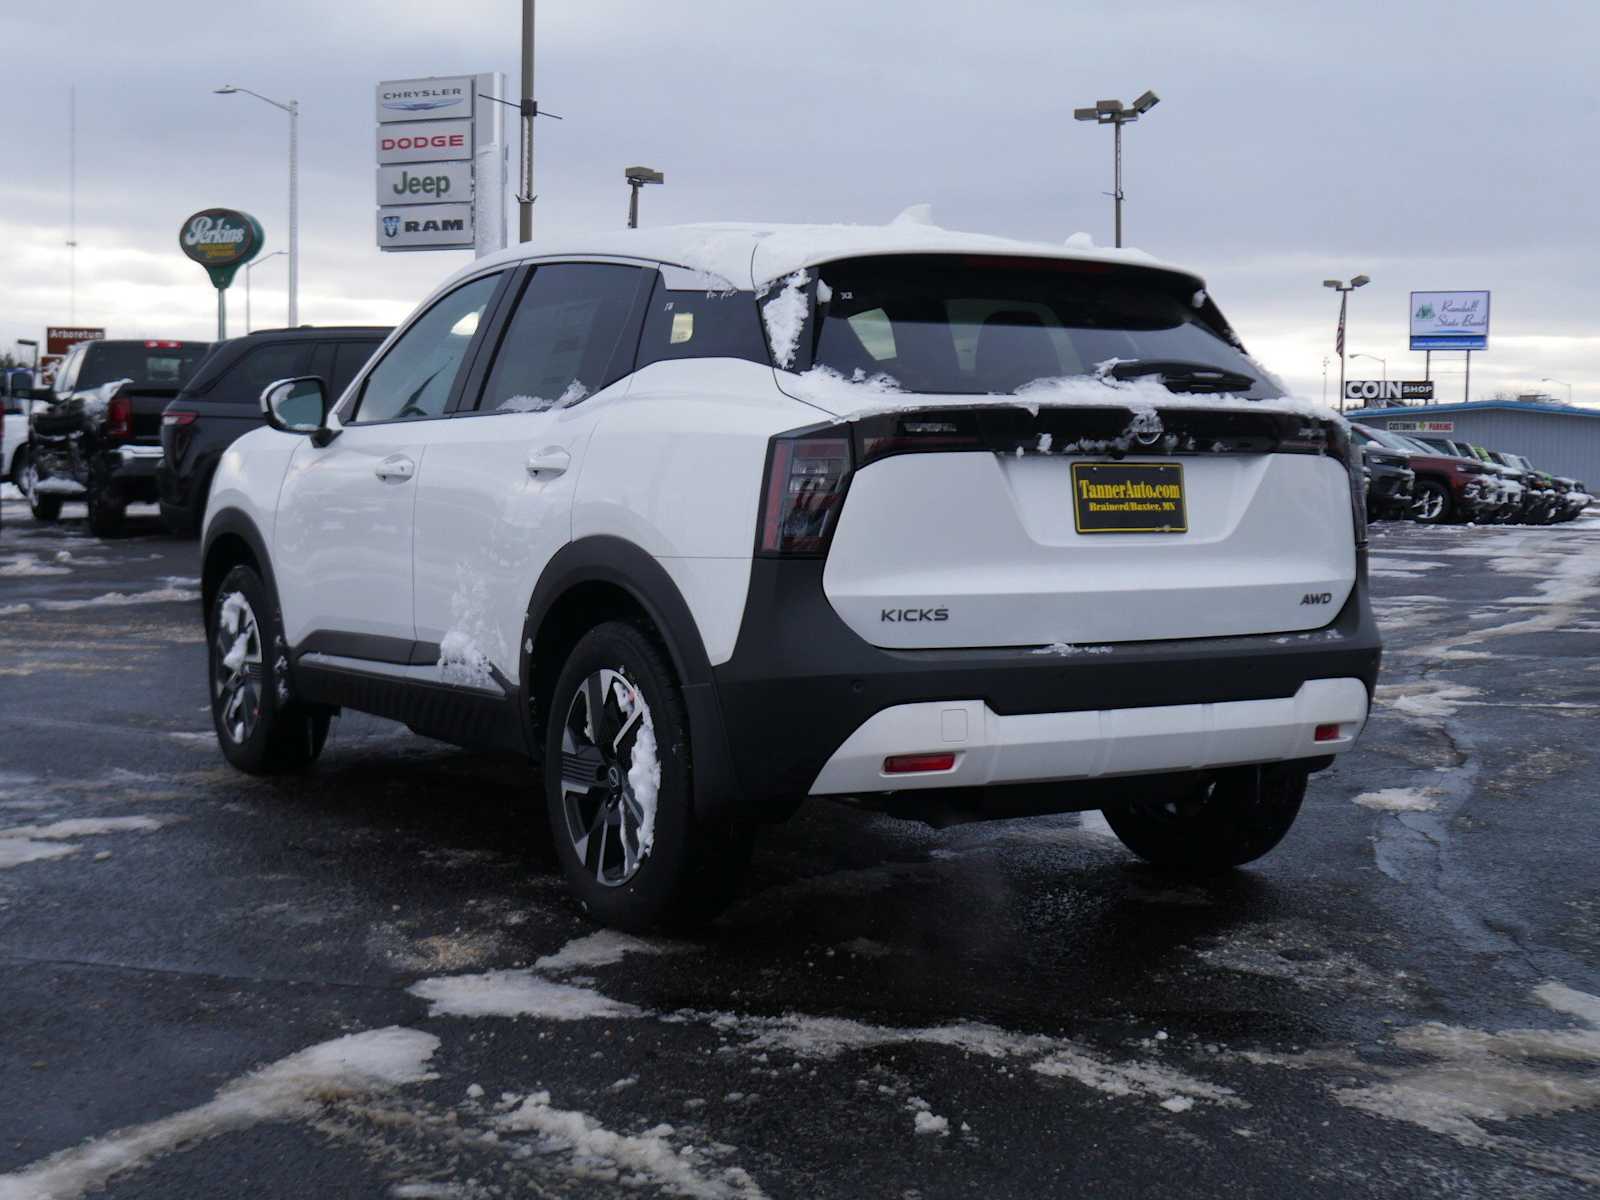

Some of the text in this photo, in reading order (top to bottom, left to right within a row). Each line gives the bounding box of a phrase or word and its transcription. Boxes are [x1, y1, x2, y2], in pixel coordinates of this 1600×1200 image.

[383, 88, 462, 100] CHRYSLER
[381, 134, 464, 151] DODGE
[393, 171, 451, 198] Jeep
[185, 216, 245, 246] Perkins
[404, 219, 464, 233] RAM
[50, 329, 104, 340] Arboretum
[1346, 381, 1433, 399] COIN SHOP
[1079, 479, 1180, 499] TannerAuto.com
[1162, 502, 1176, 511] MN
[1299, 592, 1332, 606] AWD
[880, 608, 949, 623] KICKS
